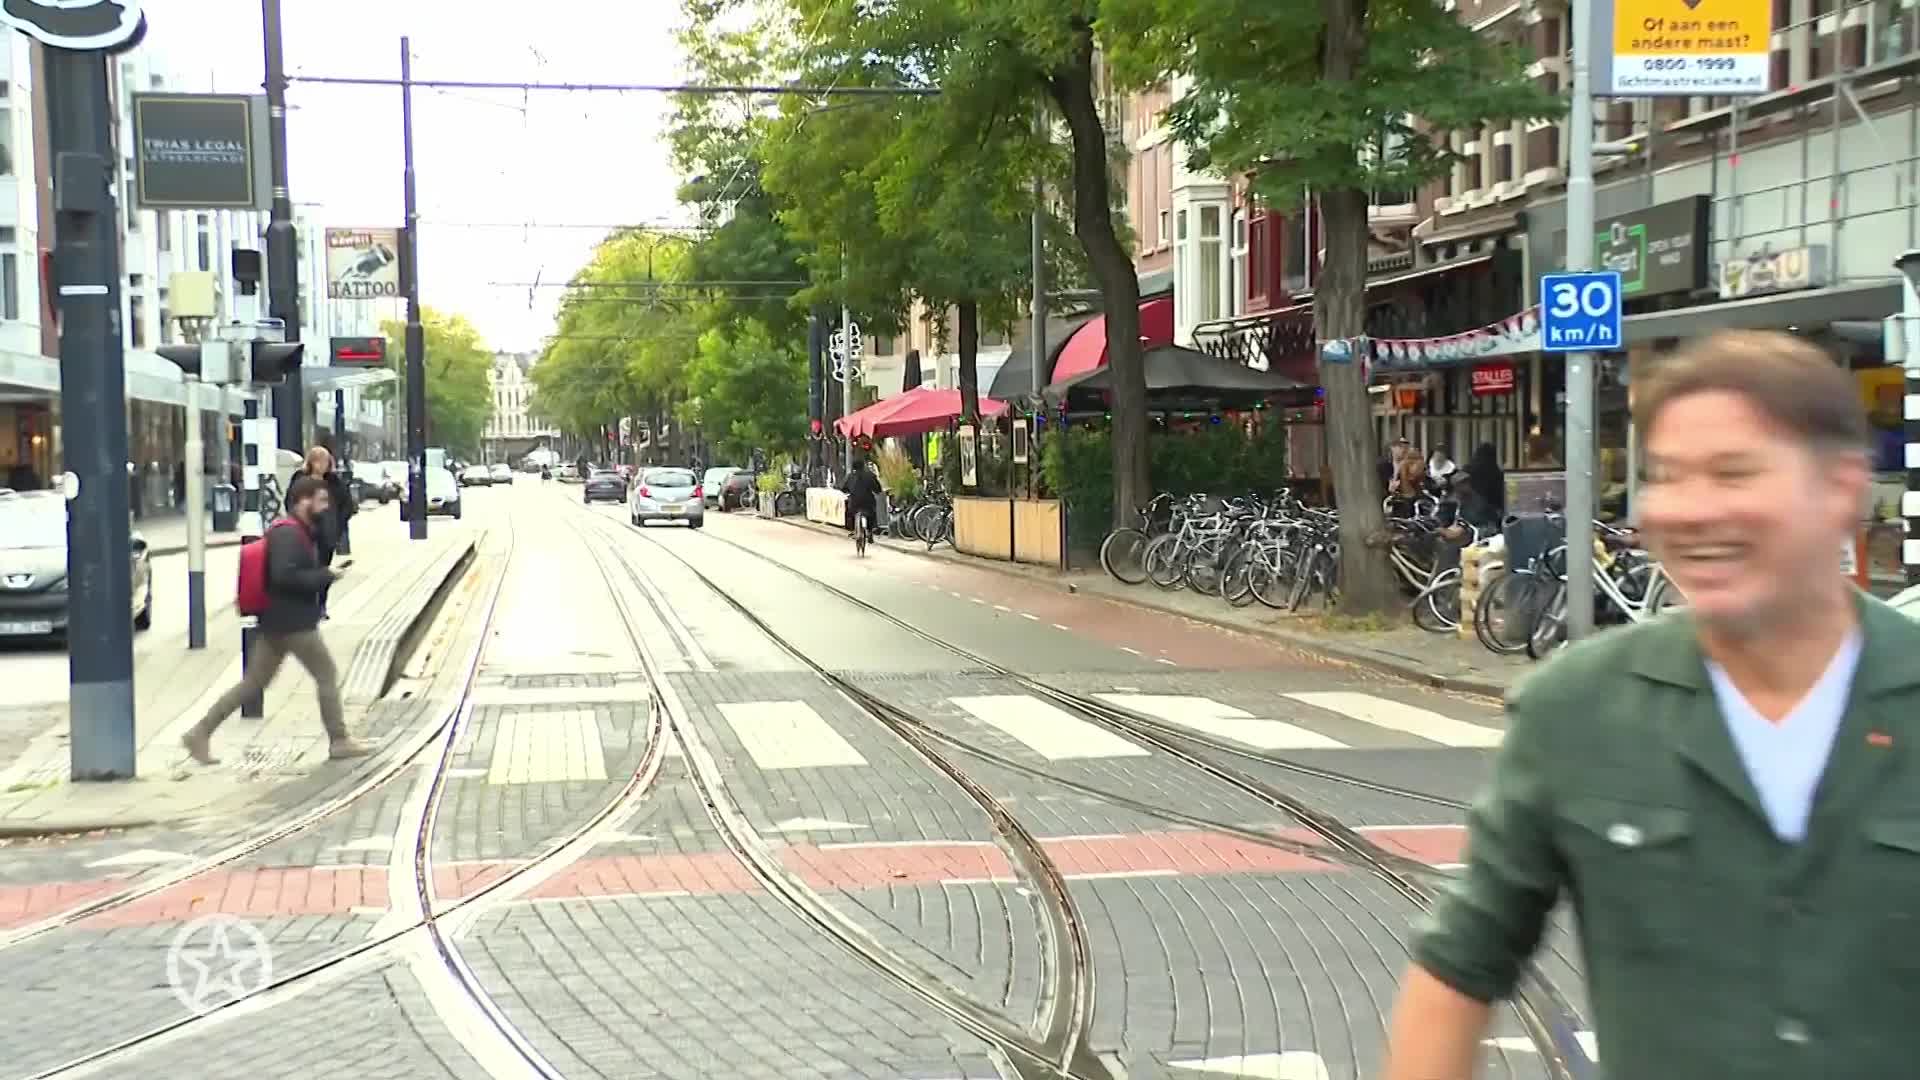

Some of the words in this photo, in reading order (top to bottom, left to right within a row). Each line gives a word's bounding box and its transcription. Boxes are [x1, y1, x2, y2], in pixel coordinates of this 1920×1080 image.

[1643, 17, 1664, 31] Of
[1669, 20, 1701, 31] aan
[1707, 20, 1739, 31] een
[1632, 35, 1693, 49] andere
[1698, 34, 1750, 48] mast?
[1618, 75, 1761, 87] lichtmastreclame.nl
[143, 138, 191, 150] TRIAS
[195, 139, 244, 151] LEGAL
[331, 280, 397, 297] TATTOO
[1550, 281, 1613, 318] 30
[1550, 322, 1613, 343] km/h
